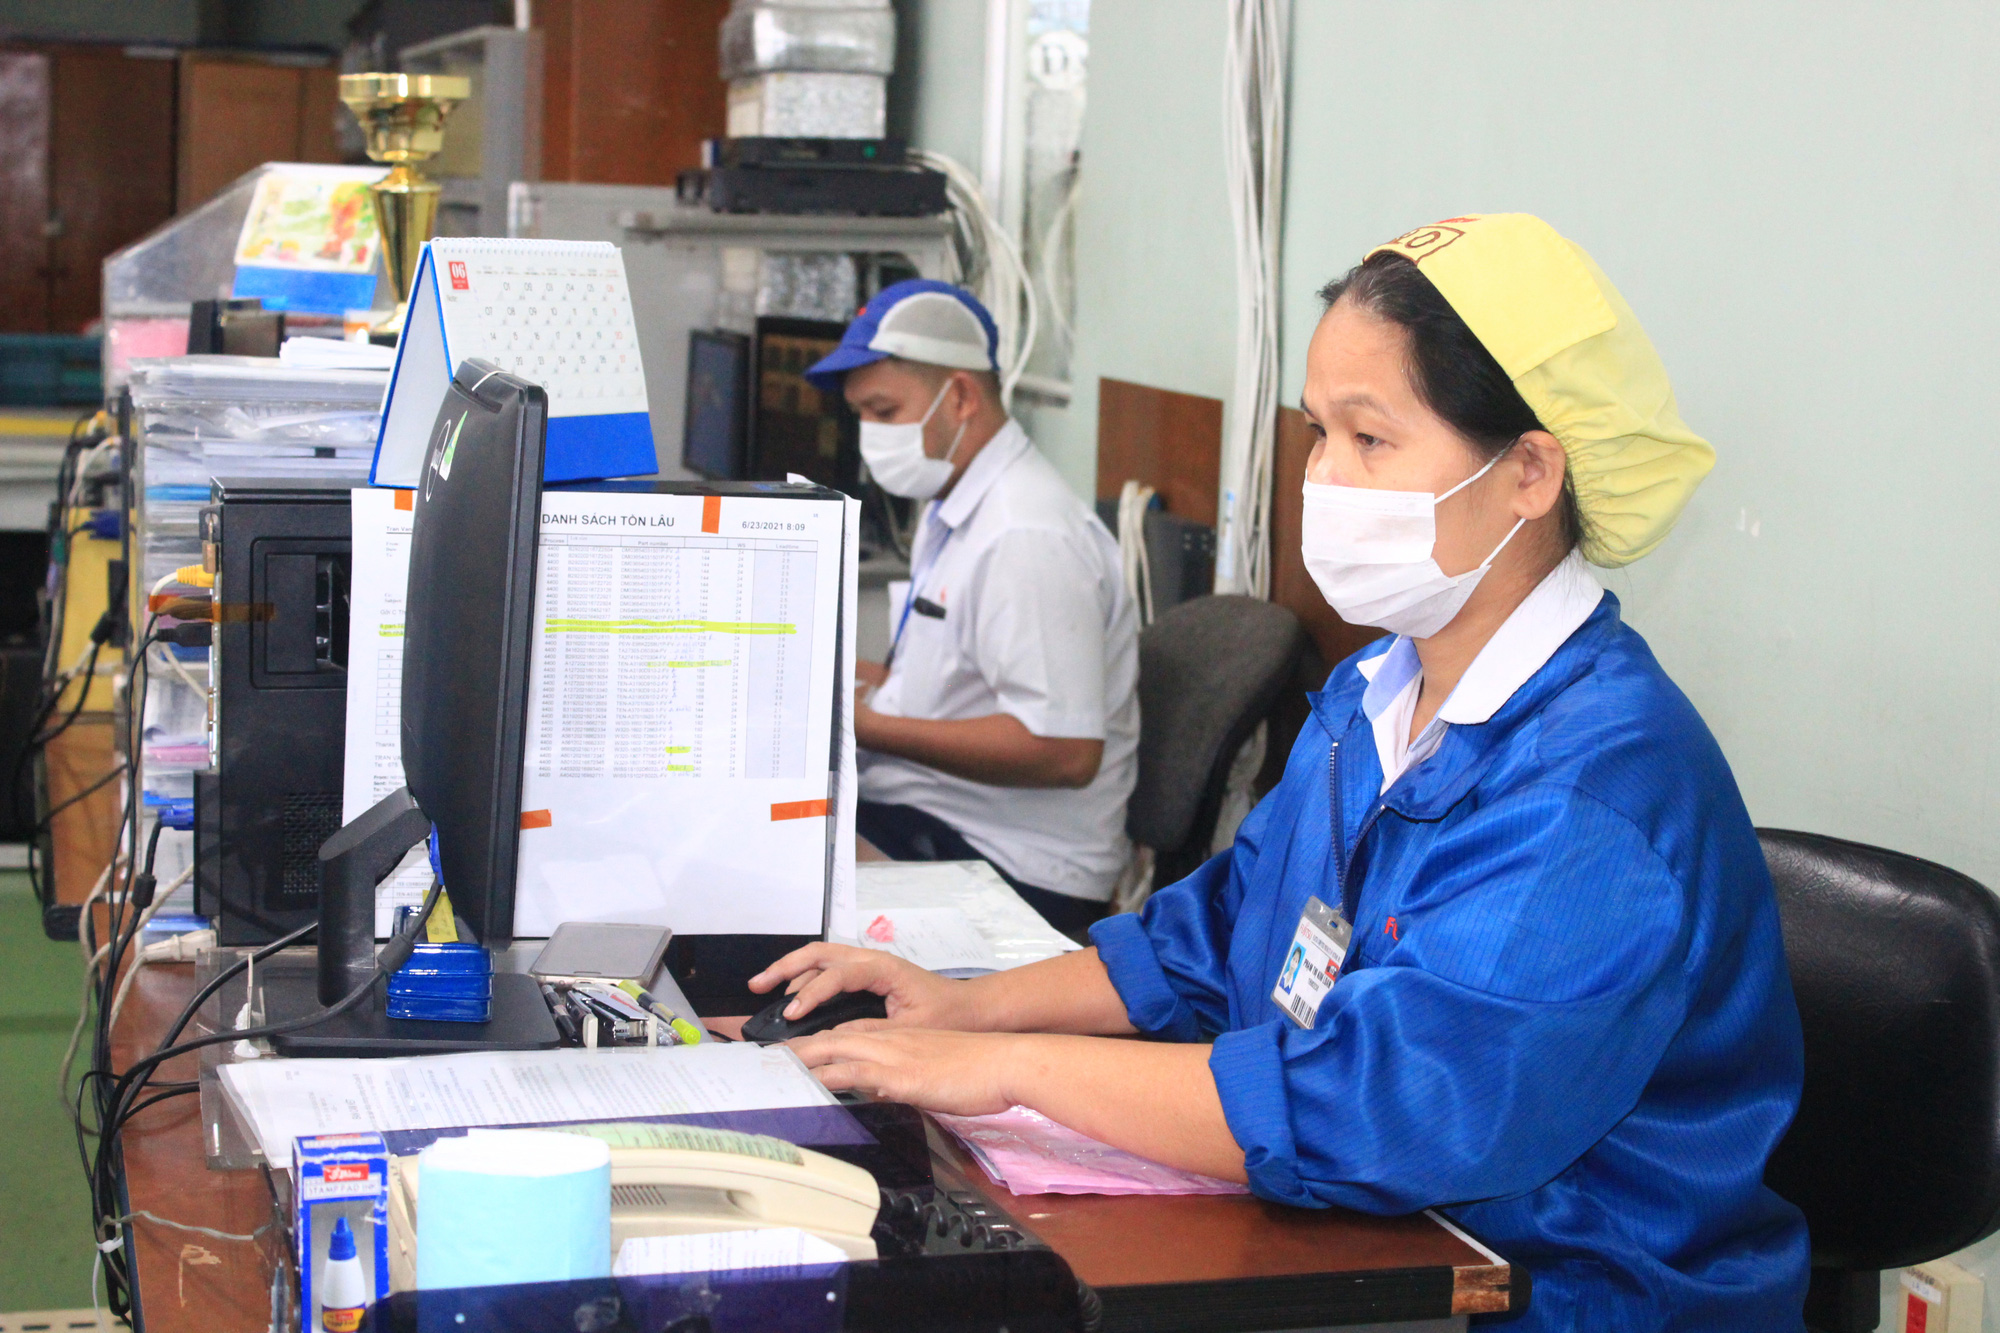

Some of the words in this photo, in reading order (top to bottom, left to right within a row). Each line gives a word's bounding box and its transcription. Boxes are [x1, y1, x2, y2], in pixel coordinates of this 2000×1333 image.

[451, 263, 466, 278] 06
[542, 514, 577, 524] DANH
[581, 512, 616, 526] SÁCH
[650, 514, 675, 527] LÂU
[742, 521, 783, 530] 6/23/2021
[786, 522, 806, 531] 8:09
